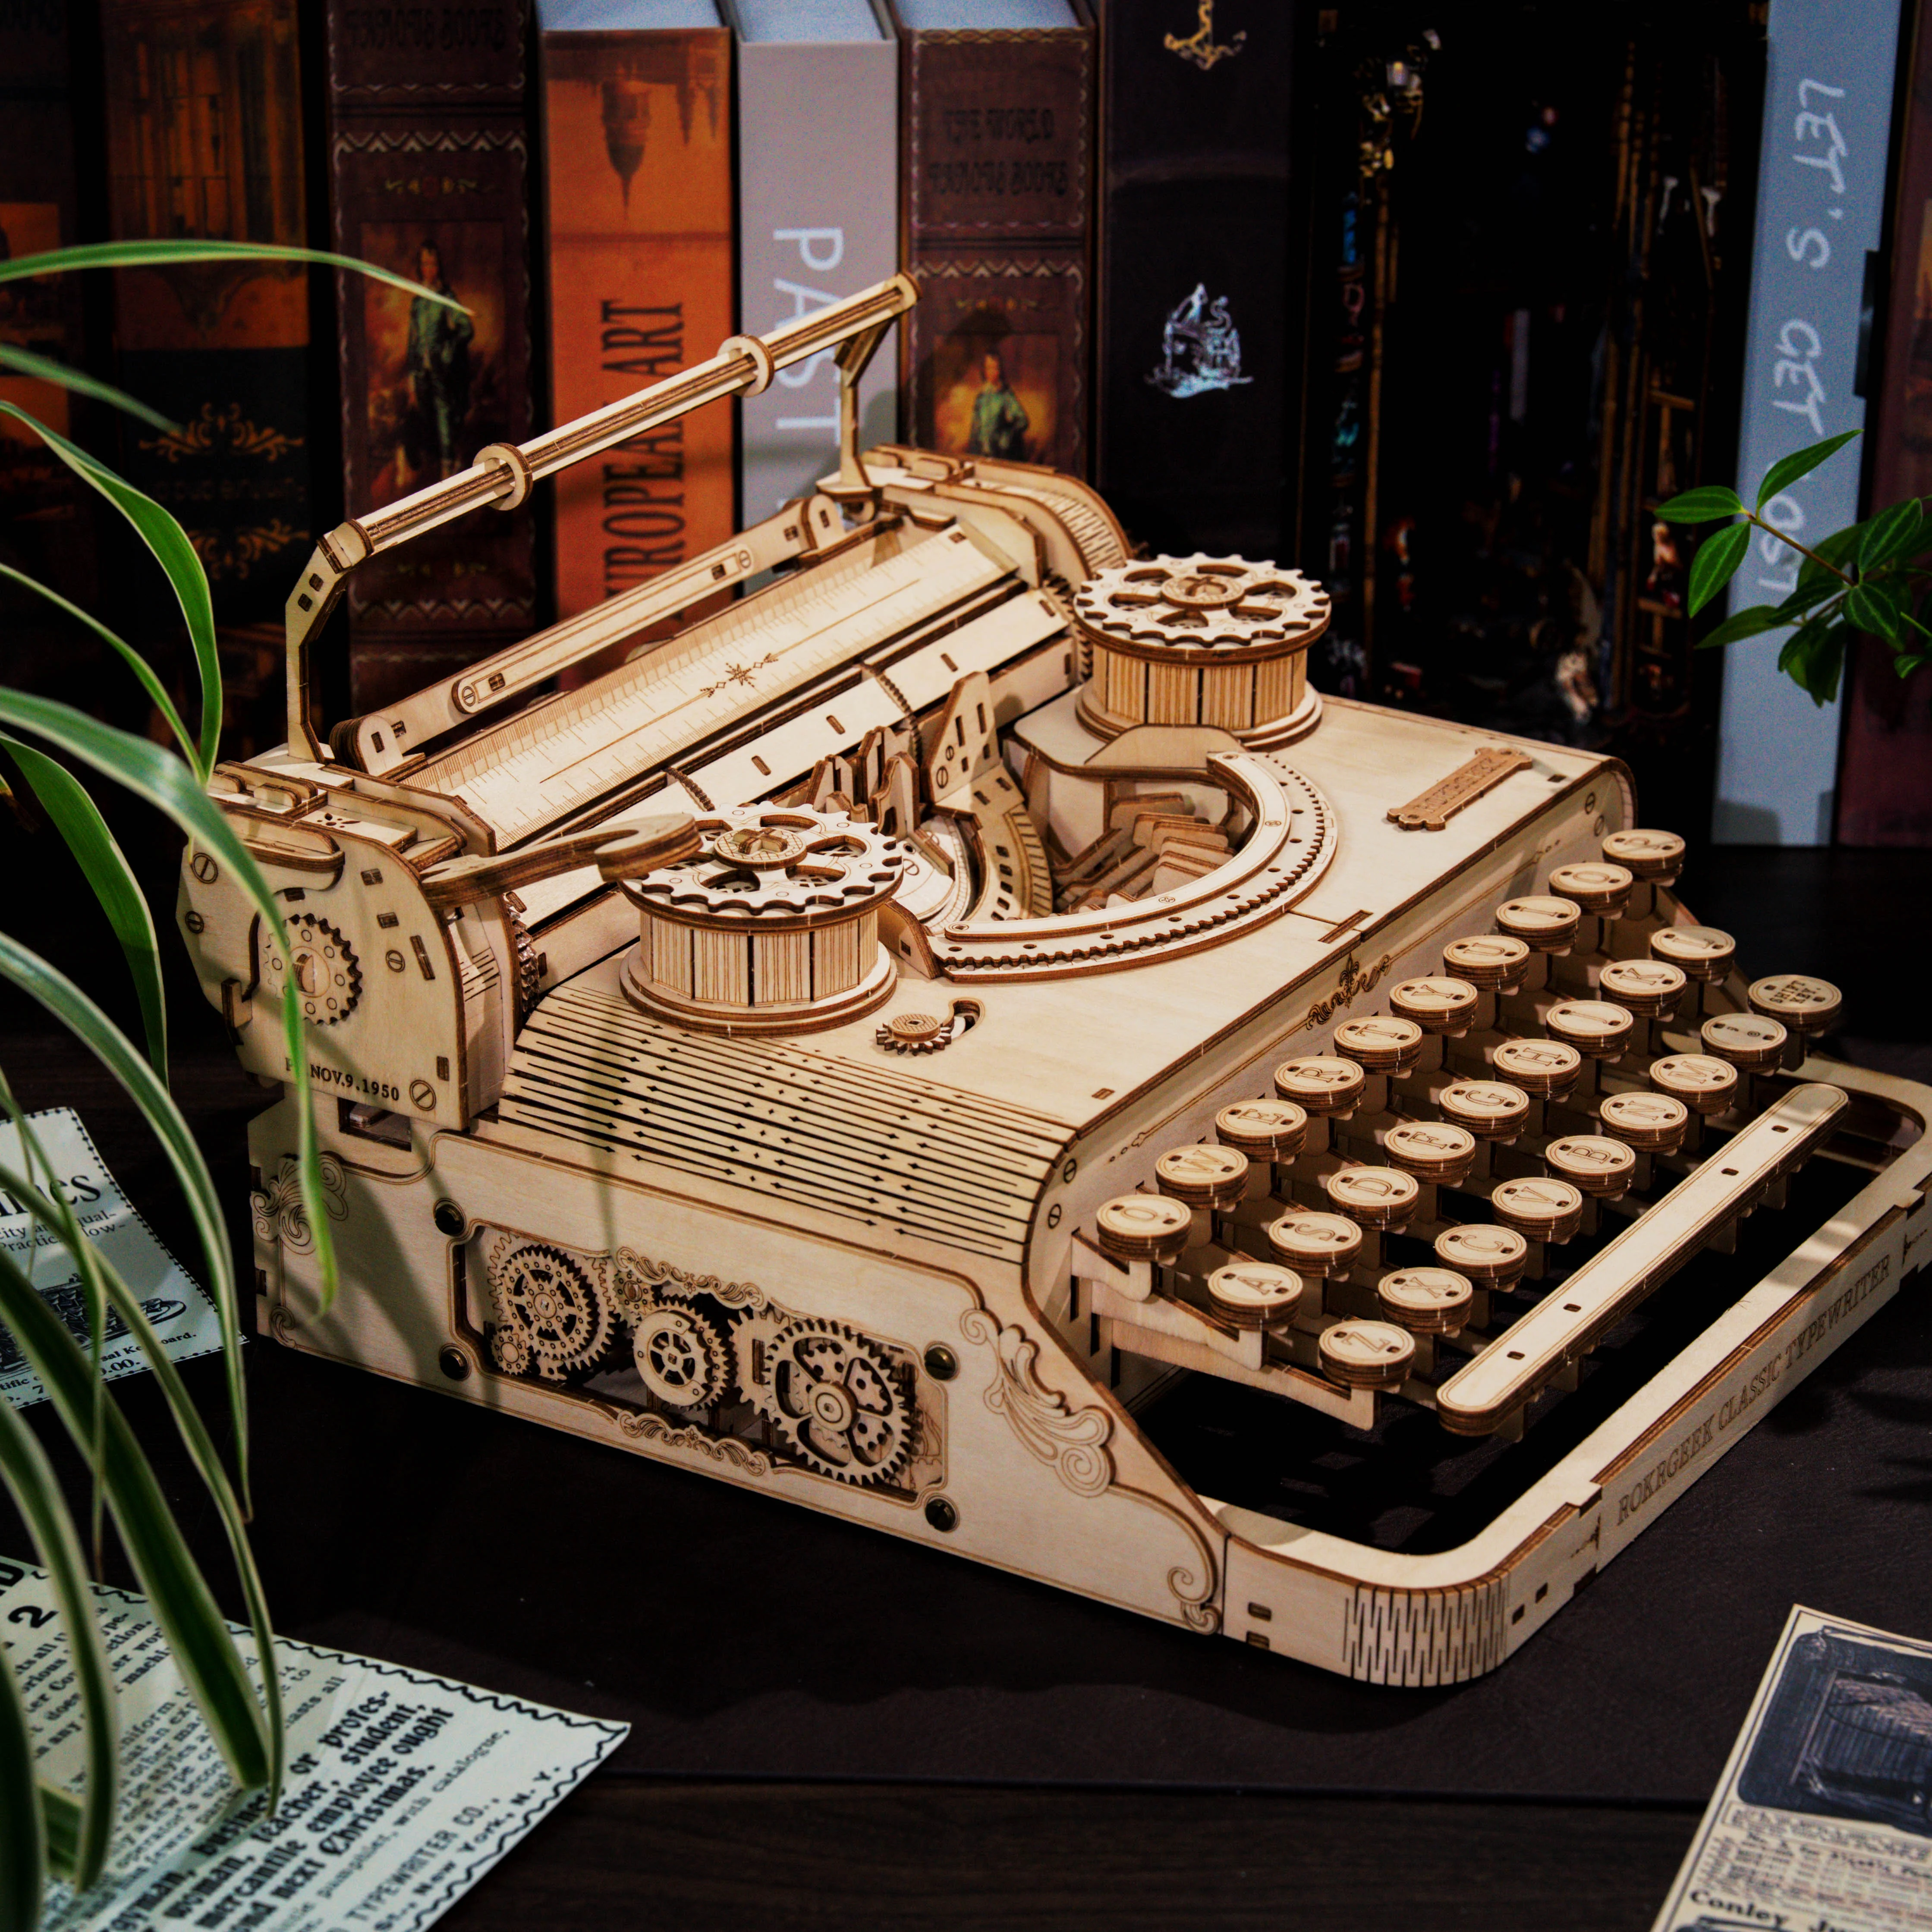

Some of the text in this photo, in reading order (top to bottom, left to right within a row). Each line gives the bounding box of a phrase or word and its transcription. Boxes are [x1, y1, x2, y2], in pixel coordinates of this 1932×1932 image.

[1785, 78, 1847, 270] LET'S
[600, 299, 685, 375] ART
[1772, 318, 1825, 436] GET
[1463, 942, 1505, 956] U
[1618, 967, 1665, 985] K
[1411, 984, 1454, 998] Y
[1770, 980, 1805, 1004] SHIFT
[1355, 1024, 1399, 1038] T
[1514, 1047, 1561, 1066] H
[1294, 1067, 1343, 1084] R
[1668, 1060, 1719, 1085] M
[1466, 1090, 1507, 1106] G
[1237, 1108, 1285, 1125] E
[1618, 1100, 1666, 1121] N
[1407, 1132, 1448, 1149] F
[1171, 1149, 1226, 1174] W
[1567, 1145, 1611, 1164] B
[1348, 1177, 1393, 1196] D
[1512, 1186, 1555, 1204] V
[1295, 1223, 1335, 1241] S
[1461, 1235, 1503, 1251] C
[1237, 1276, 1282, 1295] A
[1401, 1277, 1451, 1299] X
[1343, 1331, 1391, 1353] Z
[1617, 1254, 1891, 1526] ROKRGEEK CLASSIC TYPEWRITER
[132, 1627, 164, 1652] wor
[289, 1752, 320, 1775] or
[318, 1690, 390, 1749] profes-
[432, 1728, 510, 1793] catalogue,
[250, 1779, 340, 1843] teacher,
[341, 1703, 425, 1765] student,
[193, 1838, 308, 1929] mercantile
[305, 1757, 398, 1833] employee
[392, 1707, 454, 1756] ought
[270, 1858, 326, 1899] next
[318, 1764, 436, 1856] Christmas.
[412, 1860, 456, 1896] New
[457, 1812, 516, 1854] York,
[346, 1829, 458, 1921] TYPEWRITER
[1689, 1888, 1790, 1929] Conley
